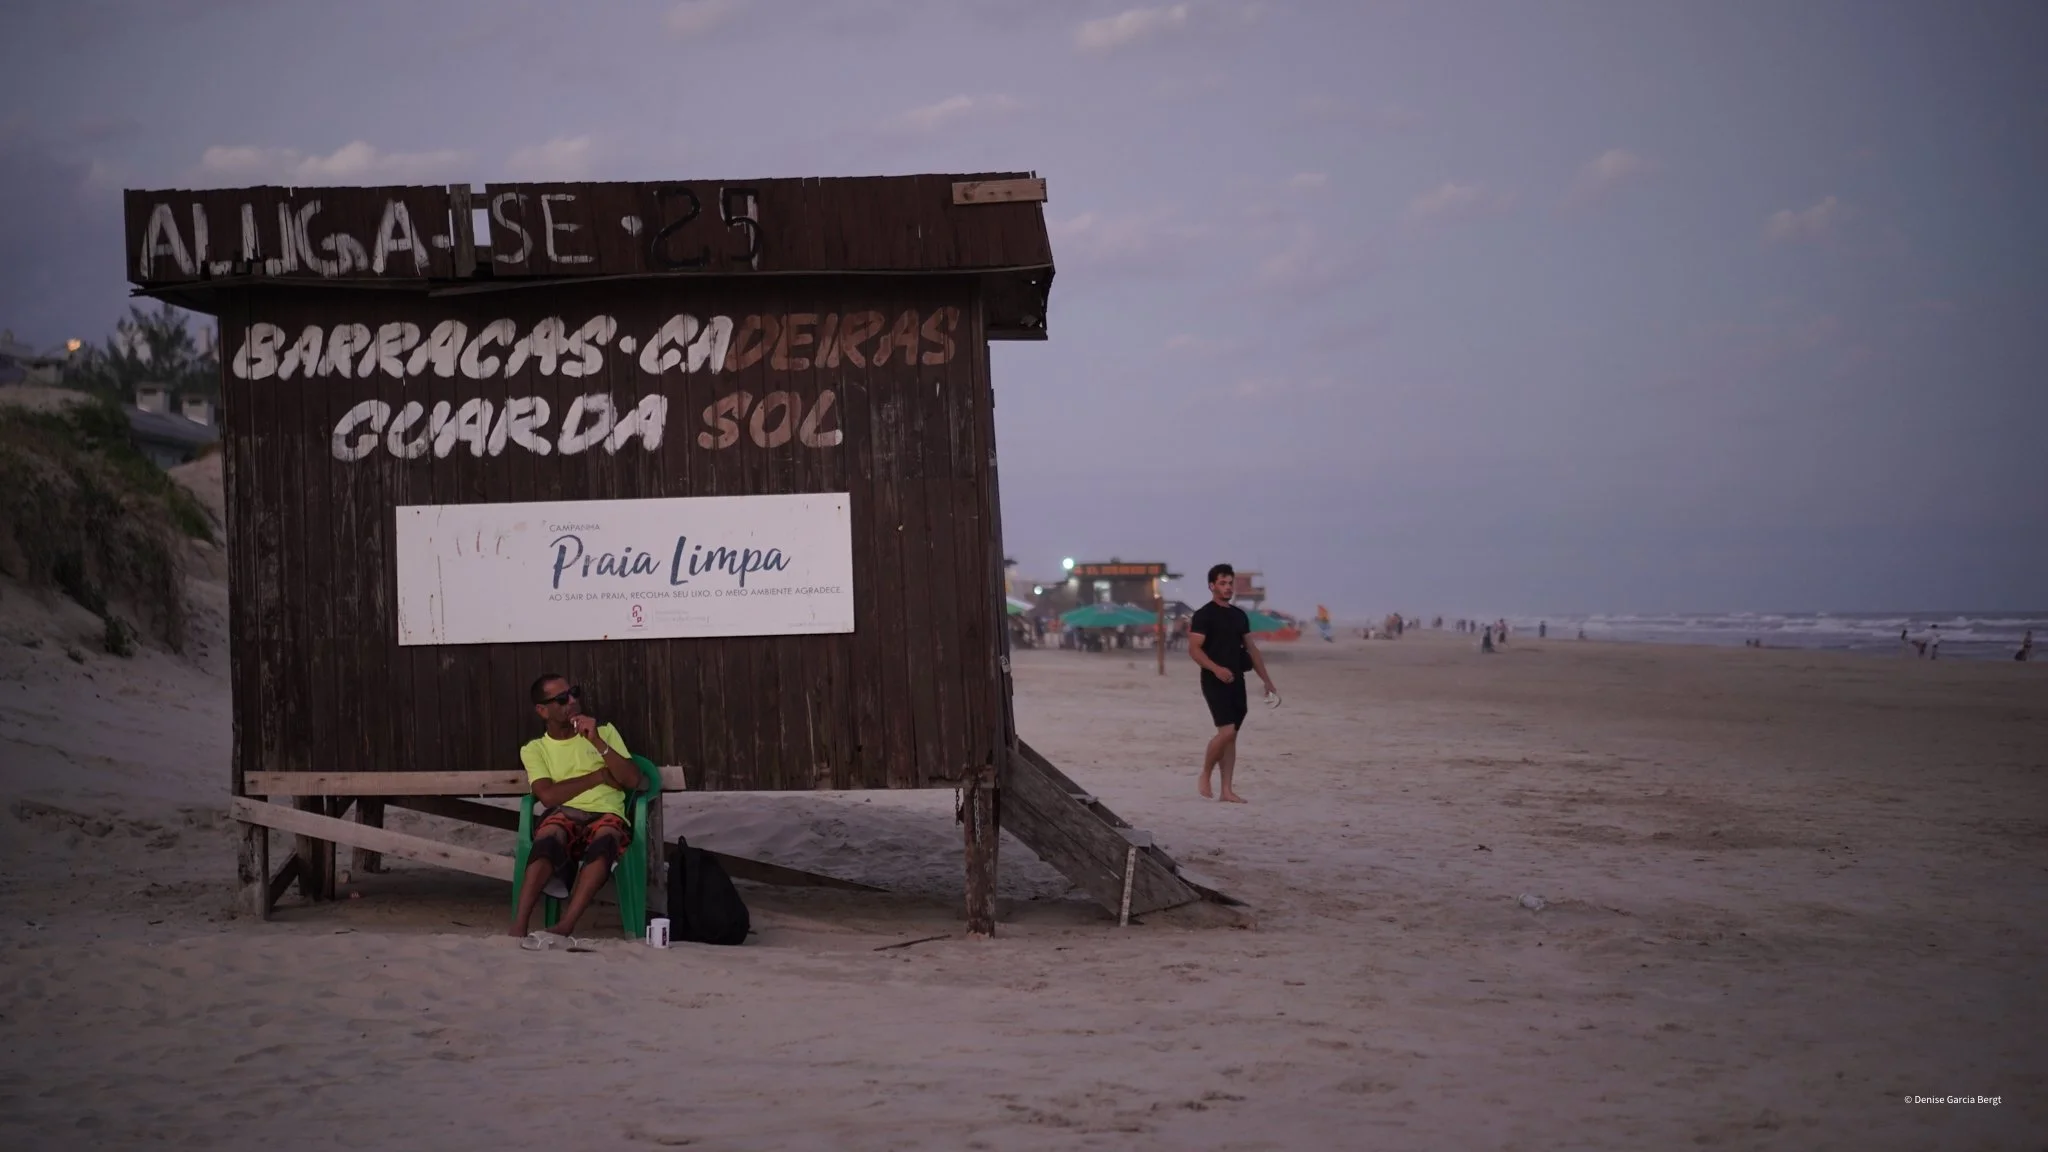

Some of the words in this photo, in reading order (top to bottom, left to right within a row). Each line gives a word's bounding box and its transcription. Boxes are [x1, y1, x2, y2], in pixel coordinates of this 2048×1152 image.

[232, 314, 617, 379] BARRACAS
[639, 306, 960, 375] CADEIRAS
[332, 392, 668, 461] GUARDA
[698, 389, 843, 449] SOL
[550, 534, 661, 589] Praia
[670, 535, 791, 588] Limpa
[549, 593, 562, 602] AO
[565, 593, 583, 601] SAIR
[601, 591, 628, 601] PRAIA,
[630, 591, 670, 600] RECOLHA
[672, 590, 689, 598] SEU
[715, 589, 723, 597] O
[725, 588, 748, 597] MEIO
[750, 587, 792, 596] AMBIENTE
